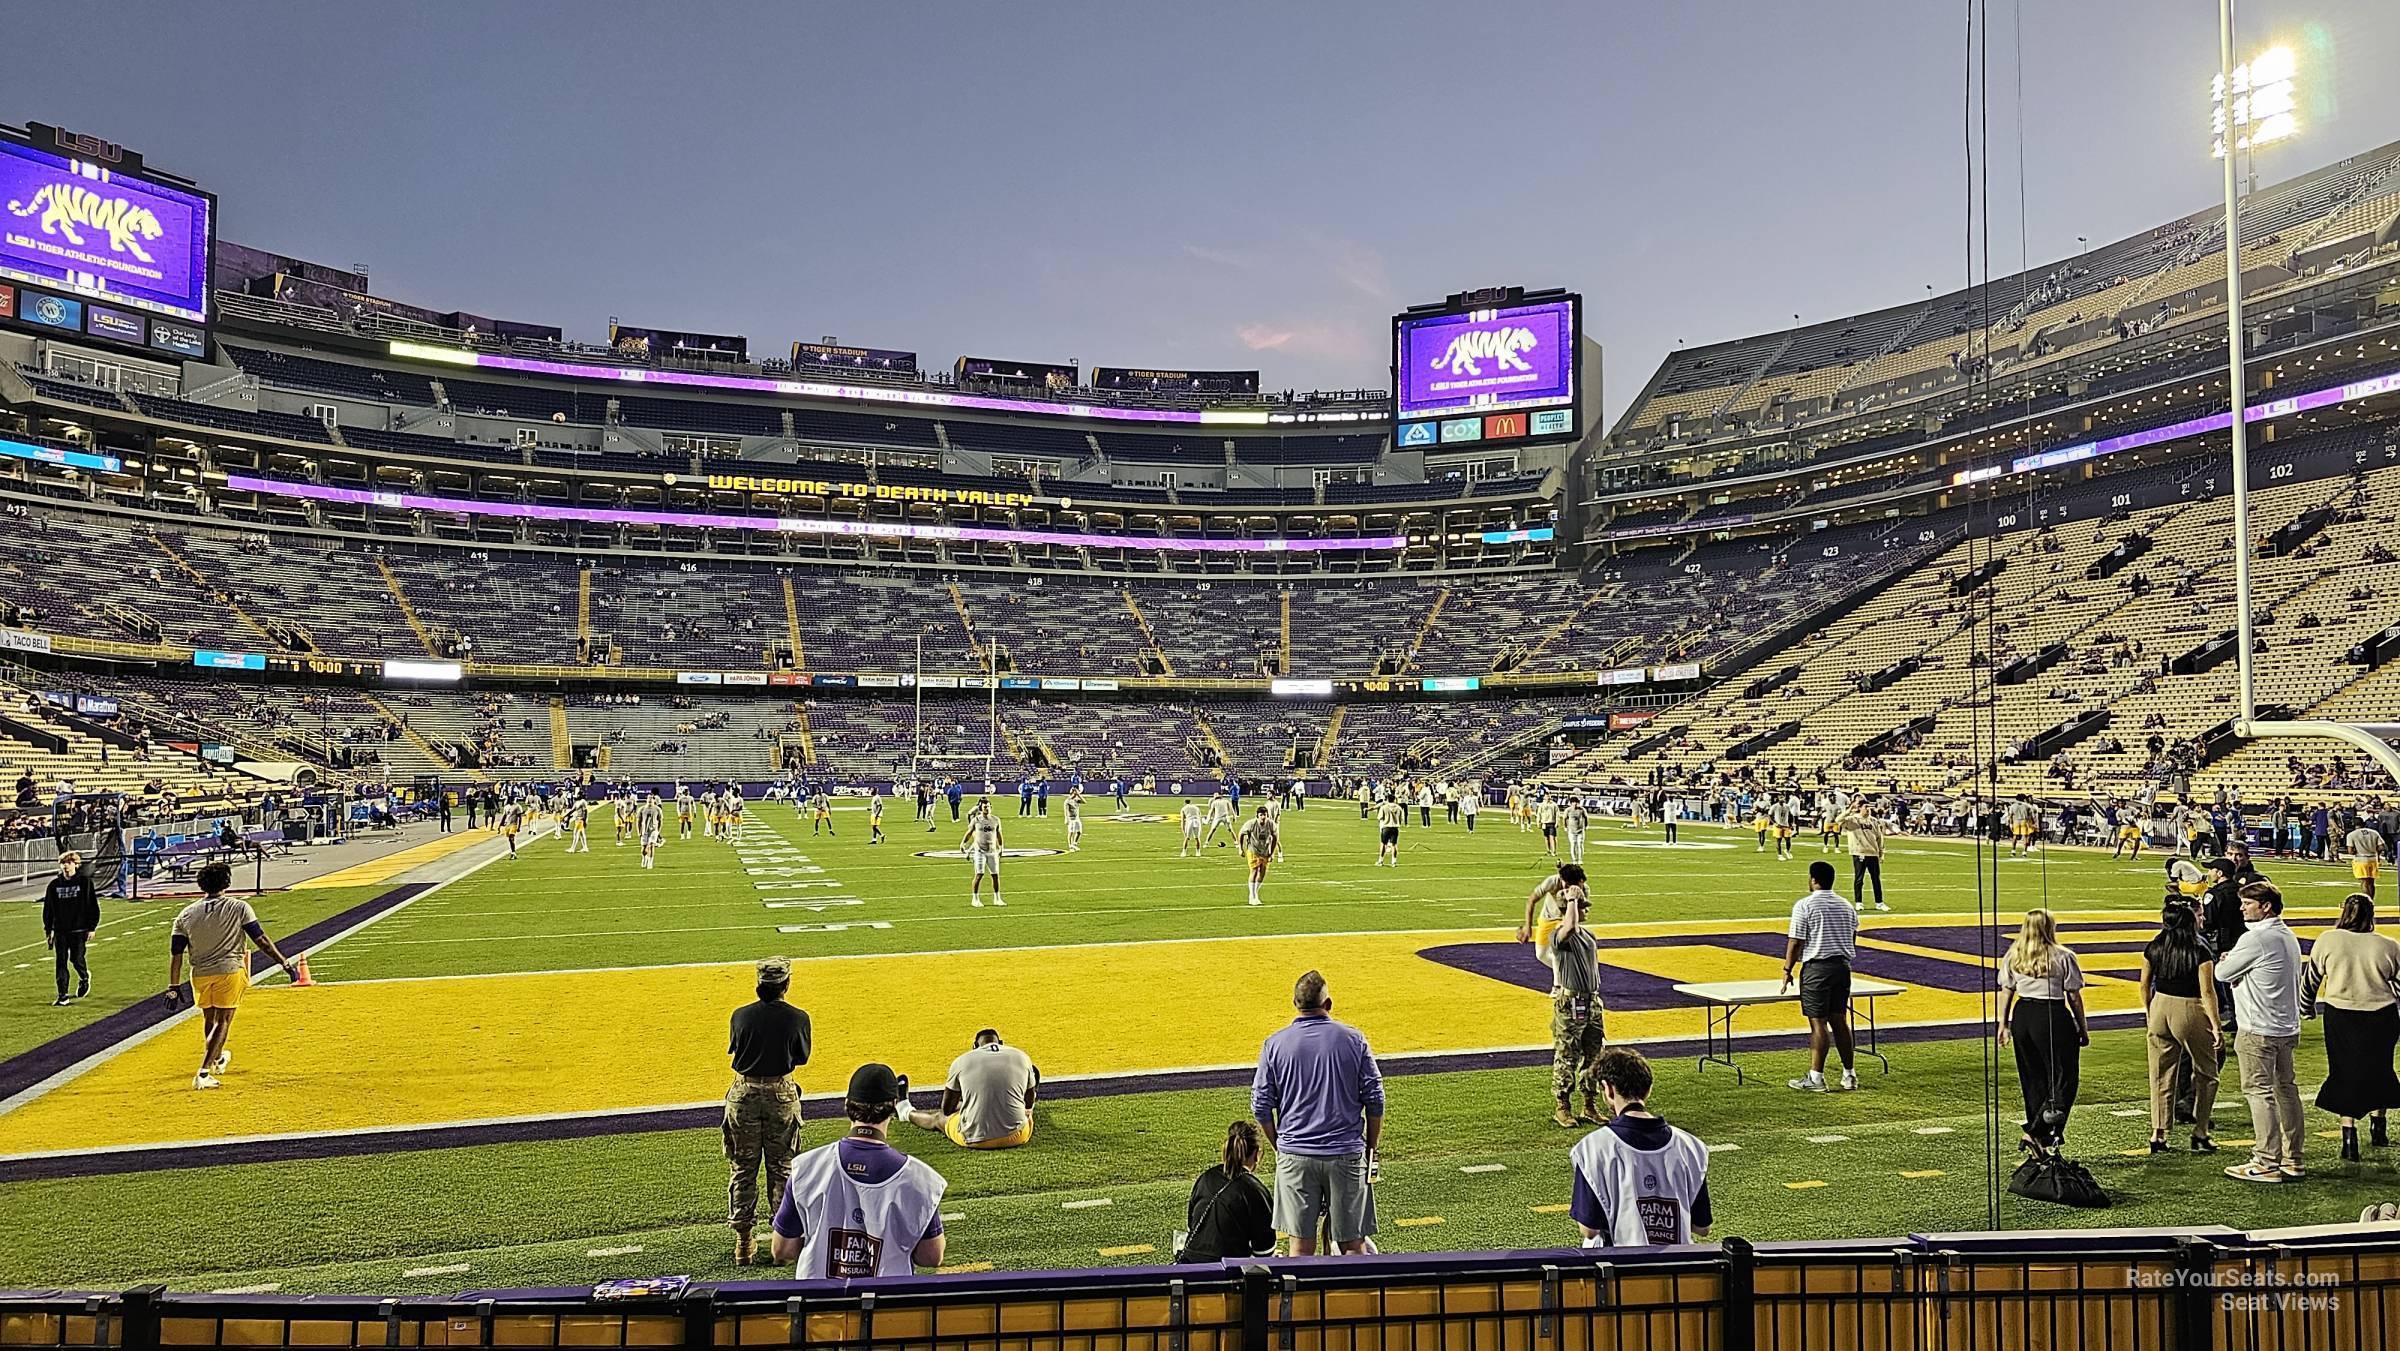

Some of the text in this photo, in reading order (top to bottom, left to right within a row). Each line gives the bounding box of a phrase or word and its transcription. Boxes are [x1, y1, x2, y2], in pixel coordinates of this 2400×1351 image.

[55, 127, 123, 163] LSU
[6, 232, 163, 280] LSU TIGER ATHLETIC FOUNDATION
[1461, 286, 1508, 306] LSU
[810, 345, 868, 357] TIGER STADIUM
[1443, 423, 1480, 437] COX
[2270, 463, 2294, 480] 102
[708, 474, 1033, 507] WELCOME TO DEATH VALLEY
[2111, 493, 2131, 508] 101
[7, 504, 27, 517] 413
[1998, 514, 2016, 528] 100
[1918, 530, 1935, 542] 424
[470, 551, 488, 562] 415
[1822, 546, 1839, 557] 423
[680, 562, 697, 572] 416
[1684, 563, 1701, 574] 422
[1027, 577, 1043, 586] 418
[1196, 582, 1211, 591] 419
[13, 635, 48, 650] TACO BELL
[309, 660, 342, 674] 90:00
[87, 698, 118, 714] Marathon
[847, 1162, 866, 1172] LSU
[1640, 1203, 1674, 1217] FARM
[1642, 1215, 1674, 1229] REAU
[1648, 1230, 1675, 1241] RANCE
[840, 1265, 869, 1275] INSURAN
